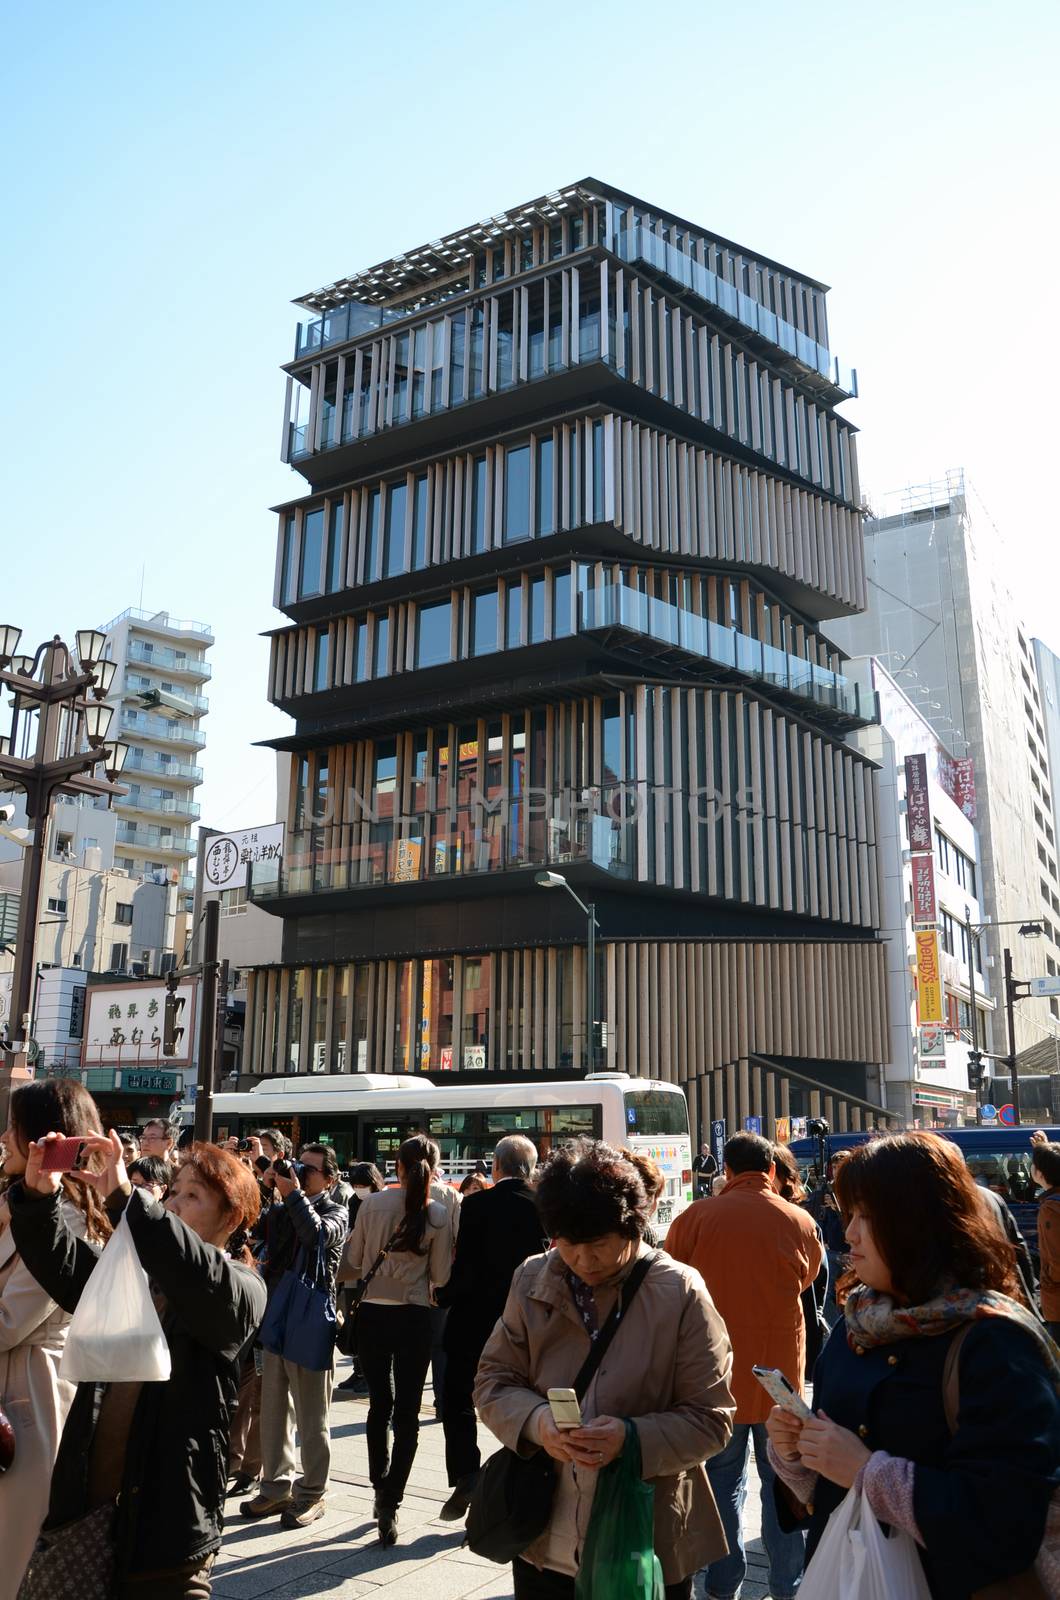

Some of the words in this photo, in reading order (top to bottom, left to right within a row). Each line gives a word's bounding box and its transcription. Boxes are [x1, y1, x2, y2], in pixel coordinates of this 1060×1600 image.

[212, 845, 221, 880] 西むら
[917, 934, 938, 984] Denny's
[109, 1026, 162, 1049] 西むら
